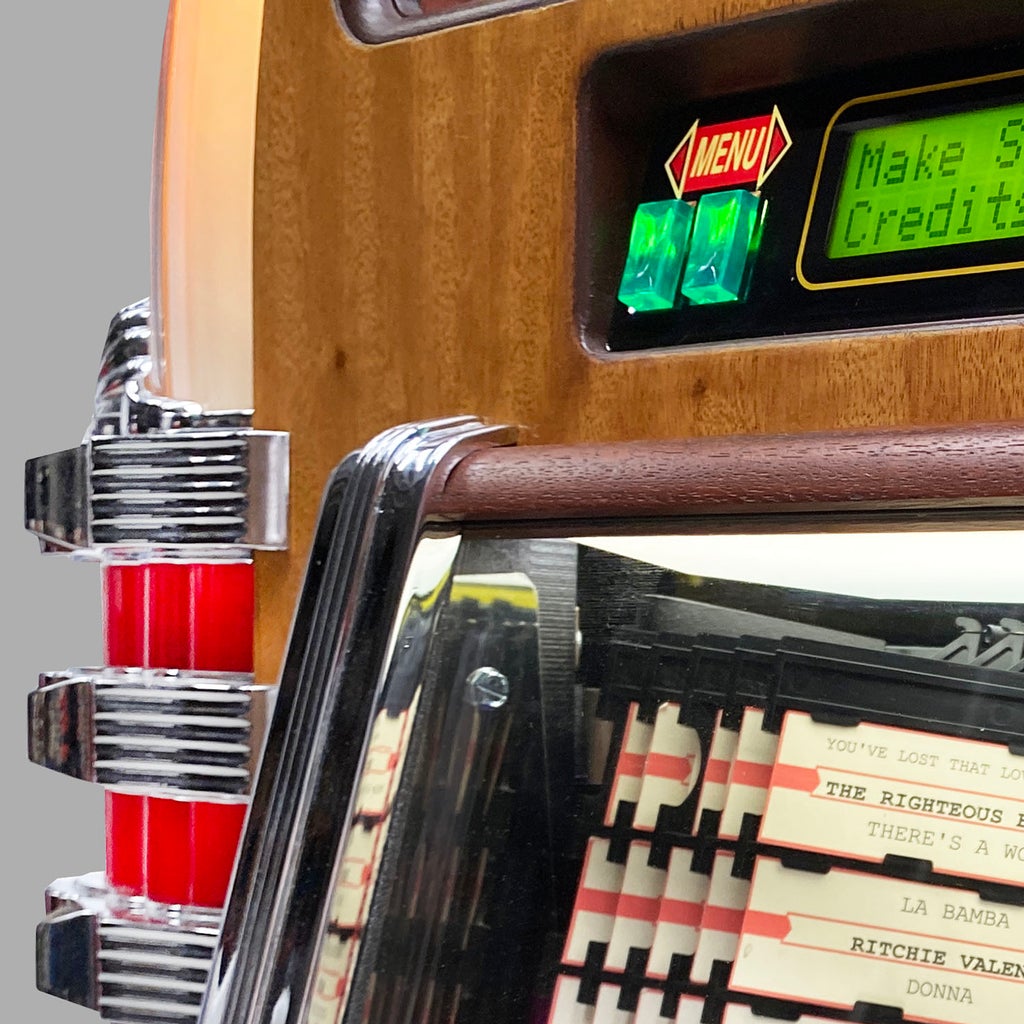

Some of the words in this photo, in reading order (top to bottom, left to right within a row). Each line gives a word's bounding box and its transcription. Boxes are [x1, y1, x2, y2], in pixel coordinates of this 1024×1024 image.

[691, 125, 763, 179] MENU
[857, 136, 964, 188] Make
[827, 737, 888, 759] YOU'VE
[897, 750, 939, 768] LOST
[950, 758, 989, 776] THAT
[826, 780, 866, 802] THE
[880, 791, 1003, 824] RIGHTEOUS
[868, 821, 962, 851] THERE'S
[975, 839, 989, 856] A
[901, 897, 928, 916] LA
[942, 903, 1011, 929] BAMBA
[850, 936, 947, 966] RITCHIE
[906, 979, 974, 1005] DONNA
